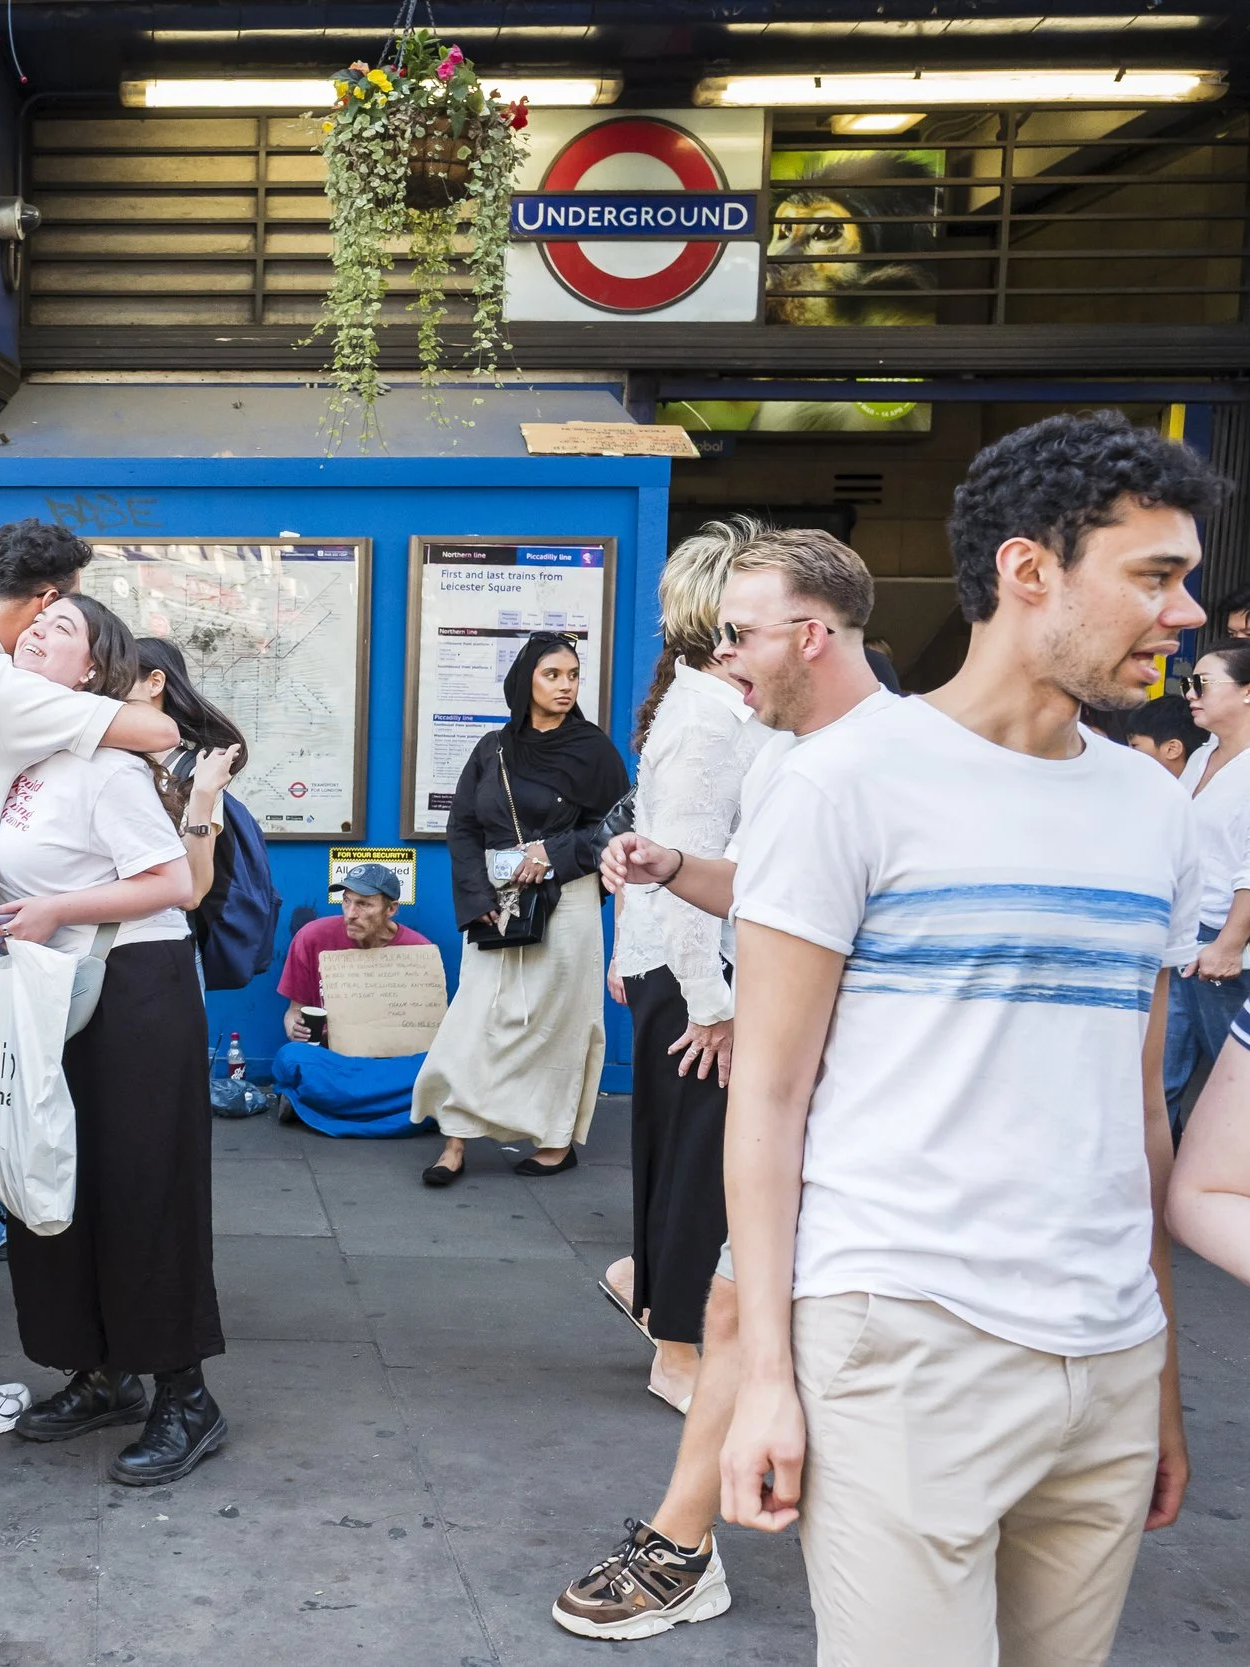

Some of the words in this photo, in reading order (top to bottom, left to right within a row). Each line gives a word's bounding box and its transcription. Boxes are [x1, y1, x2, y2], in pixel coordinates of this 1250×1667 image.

[517, 202, 749, 231] UNDERGROUND
[694, 440, 724, 453] obal
[441, 551, 472, 560] Northern
[473, 551, 487, 560] line
[526, 553, 558, 562] Piccadilly
[559, 553, 572, 561] line
[441, 569, 462, 579] First
[465, 570, 484, 580] and
[486, 570, 504, 580] last
[508, 571, 536, 581] trains
[539, 572, 563, 582] from
[440, 582, 485, 592] Leicester
[488, 583, 522, 594] Square
[439, 628, 466, 636] Northern
[336, 865, 348, 874] All
[391, 866, 410, 875] ded
